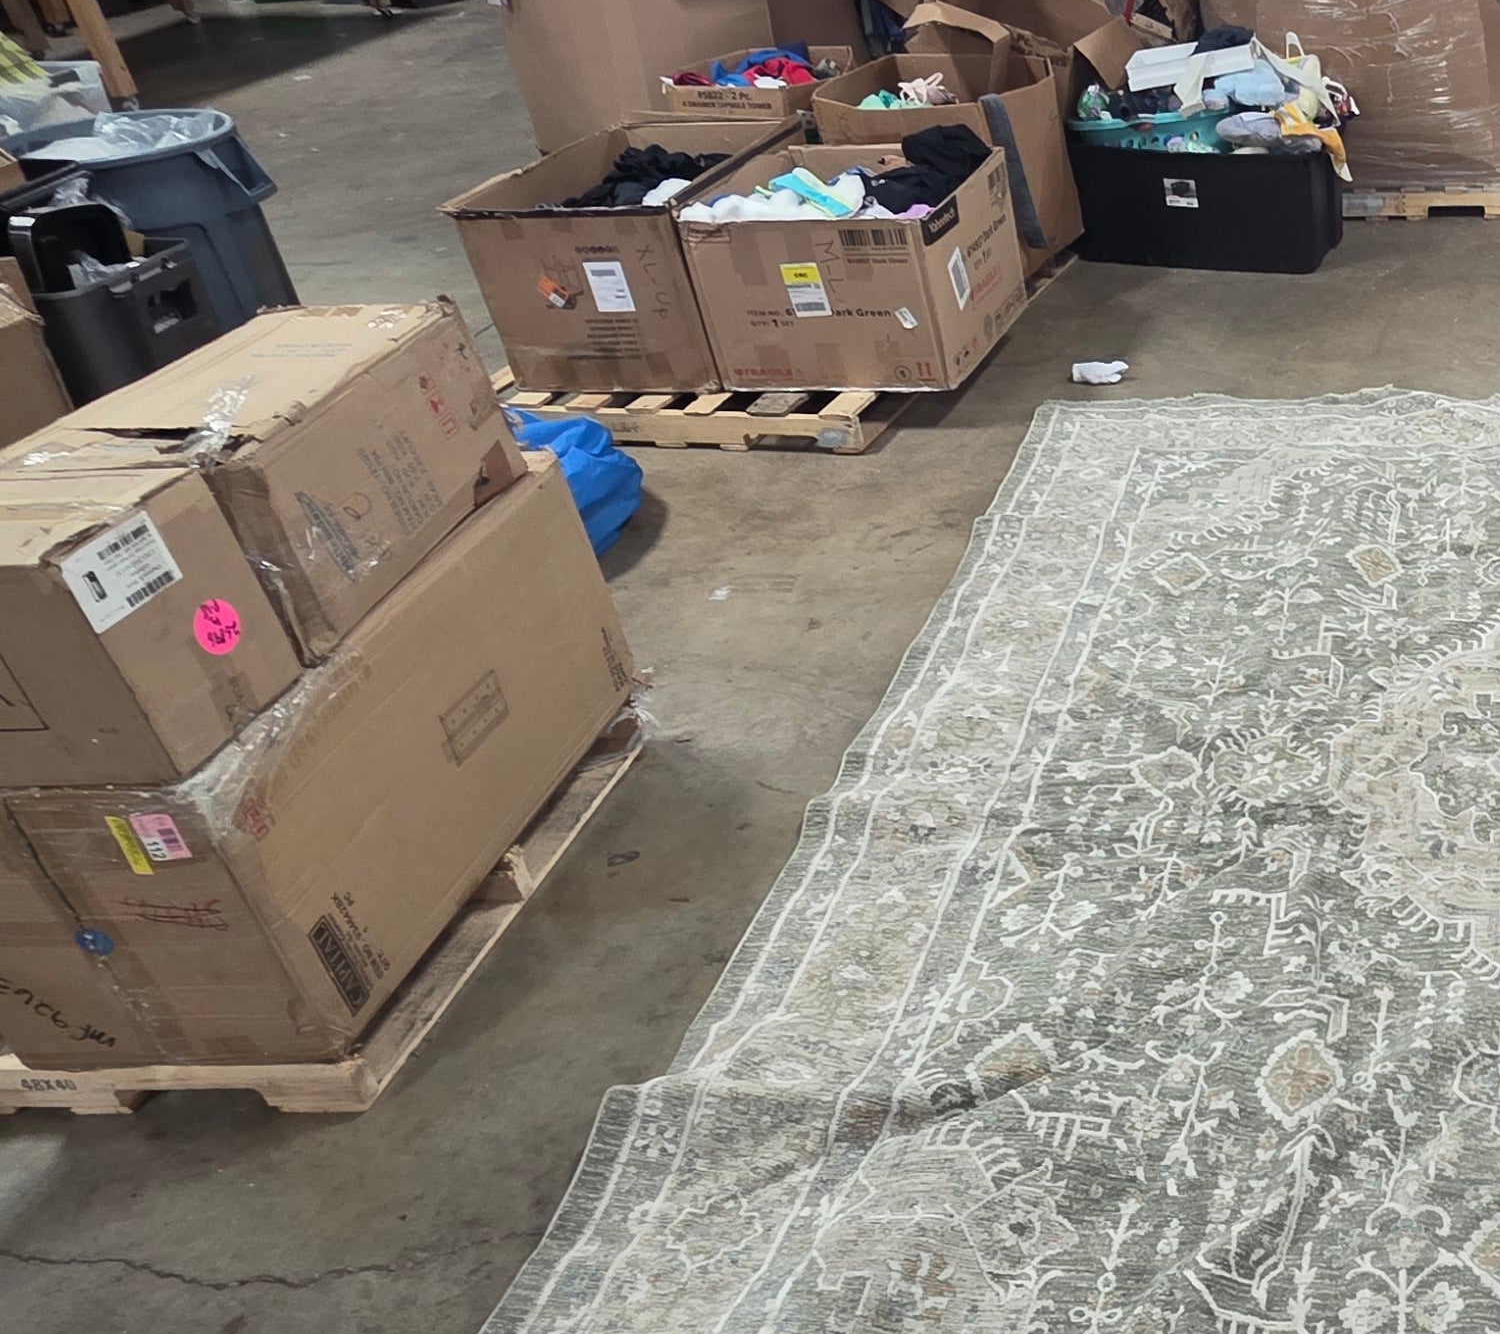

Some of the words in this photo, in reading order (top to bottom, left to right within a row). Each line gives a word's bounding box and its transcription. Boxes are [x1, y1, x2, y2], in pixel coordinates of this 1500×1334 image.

[856, 308, 891, 317] Green
[312, 920, 366, 1006] CAPITAL
[20, 1078, 78, 1092] 48X40
